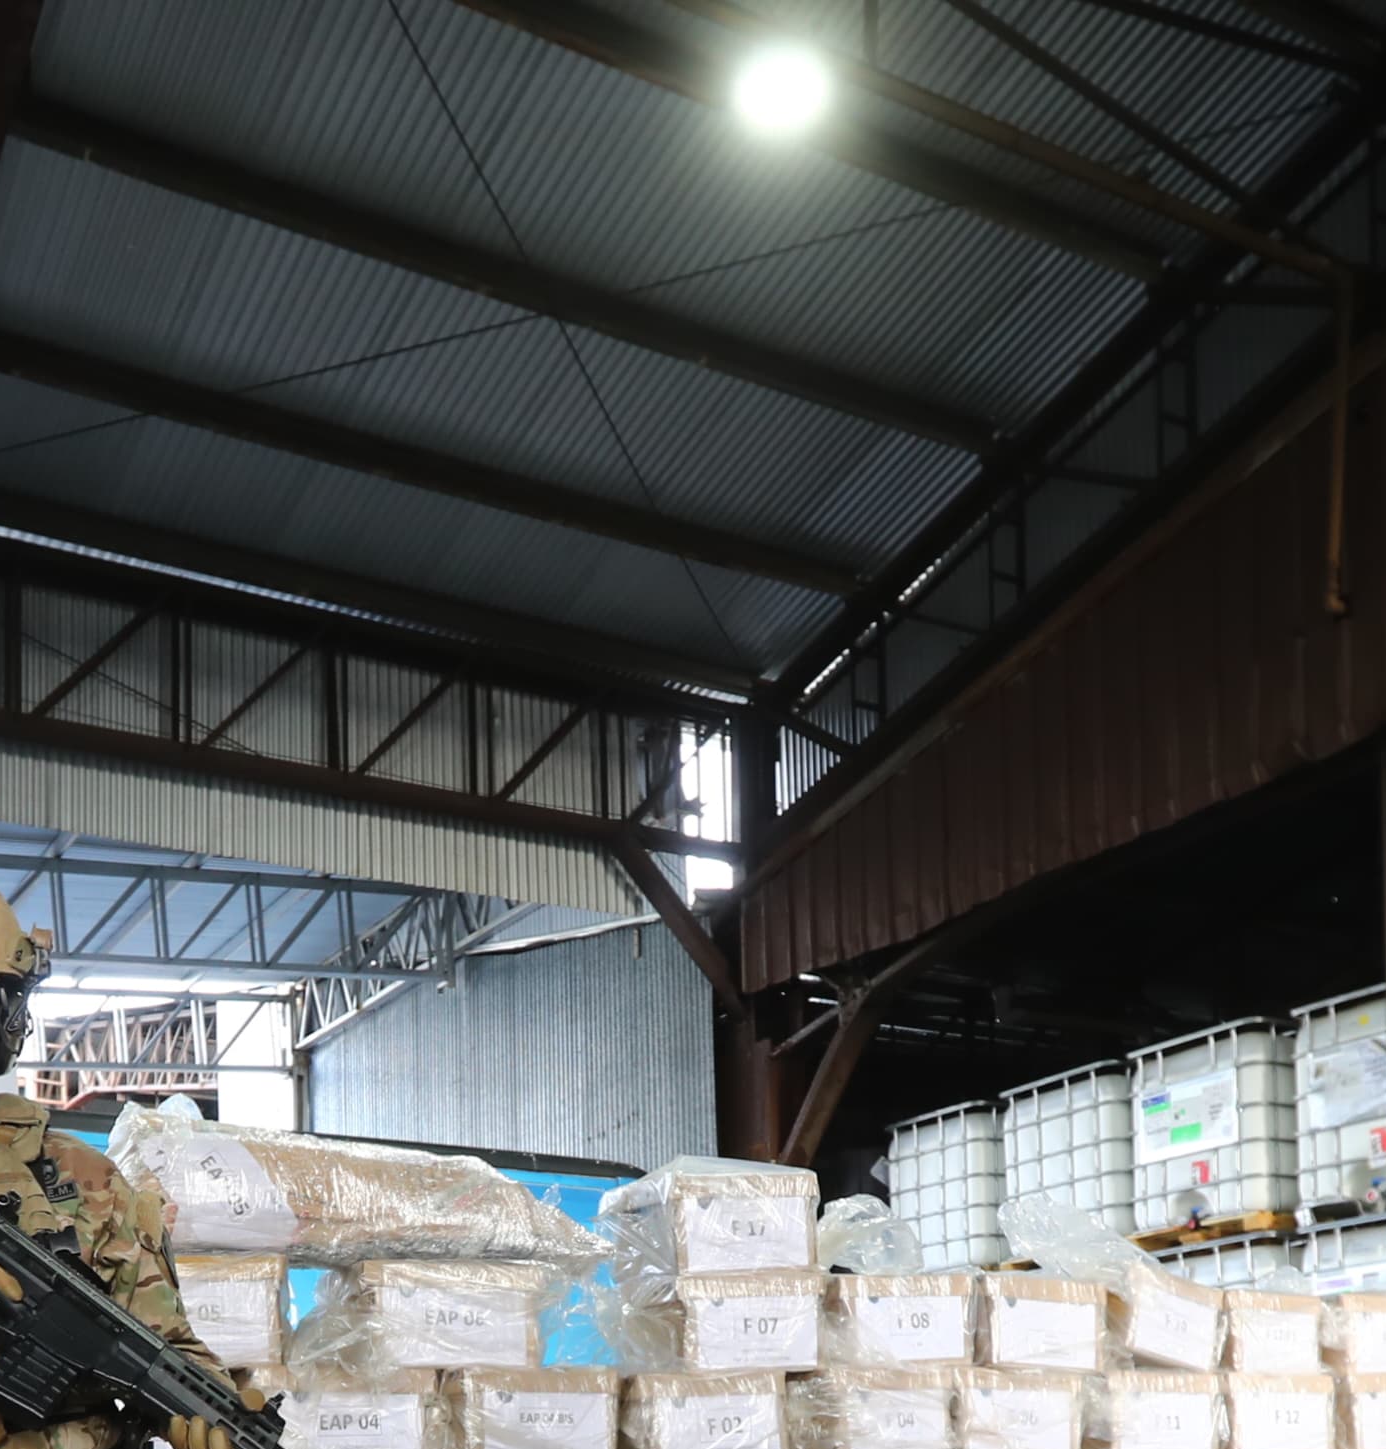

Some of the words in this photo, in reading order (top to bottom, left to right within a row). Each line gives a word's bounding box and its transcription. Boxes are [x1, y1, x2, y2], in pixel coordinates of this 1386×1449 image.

[424, 1308, 460, 1327] EAP
[743, 1318, 753, 1335] F
[757, 1317, 779, 1335] 07
[910, 1311, 931, 1329] 08
[319, 1413, 354, 1431] EAP
[358, 1413, 380, 1431] 04
[519, 1413, 541, 1424] EAP
[707, 1418, 716, 1435] F
[721, 1416, 744, 1434] 02
[1286, 1410, 1300, 1425] 12
